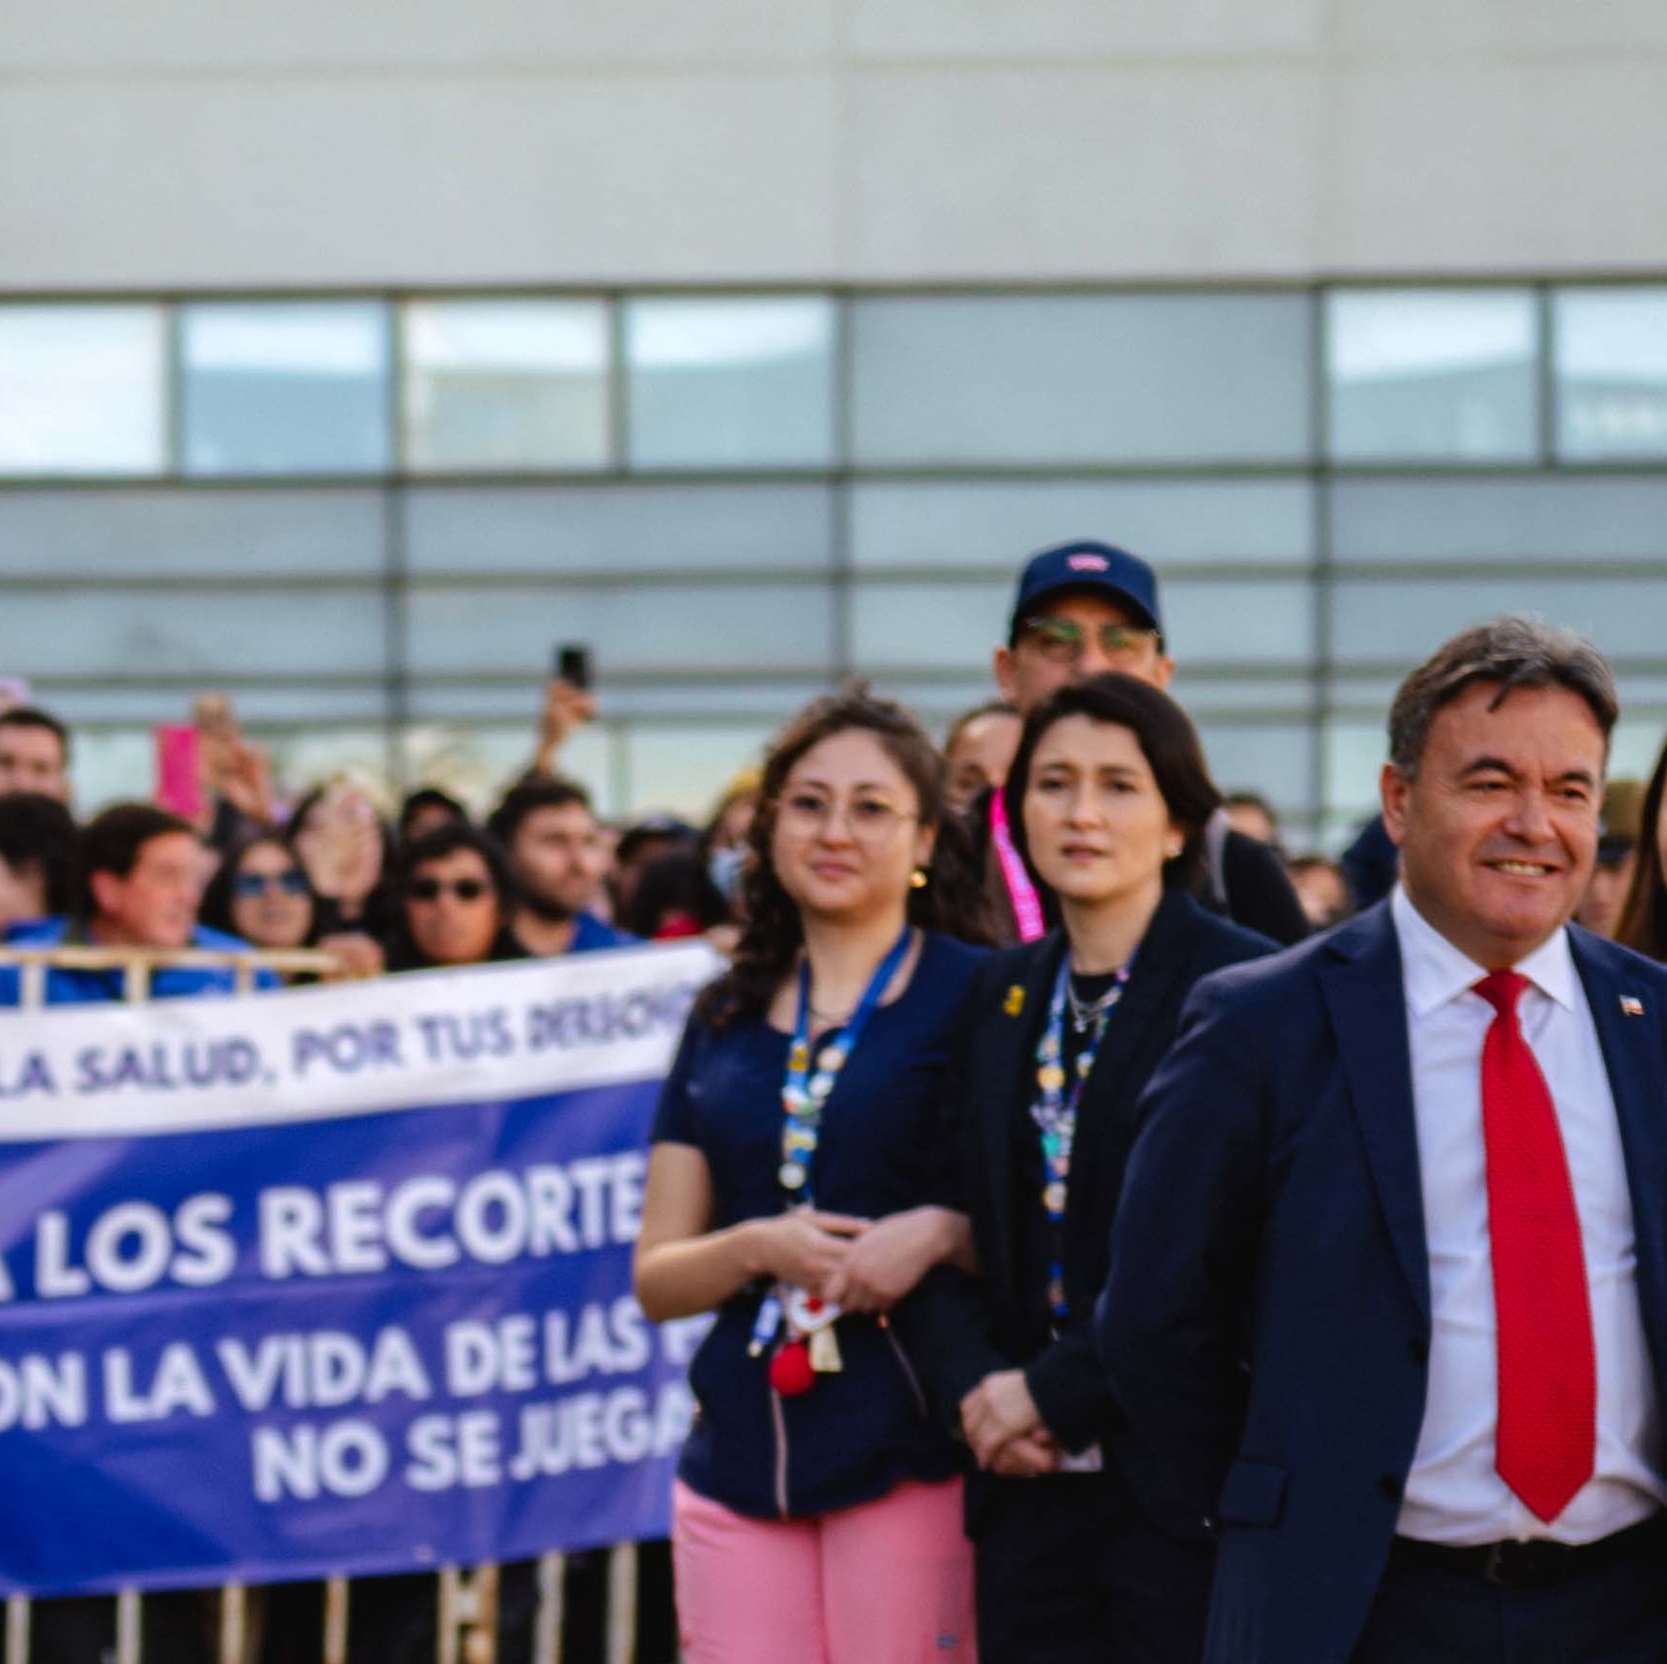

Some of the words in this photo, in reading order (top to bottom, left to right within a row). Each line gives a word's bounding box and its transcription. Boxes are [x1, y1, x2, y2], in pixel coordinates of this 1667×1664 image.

[73, 1036, 277, 1093] SALUD,
[292, 1020, 403, 1076] POR
[418, 1002, 517, 1062] TUS
[34, 1193, 238, 1297] LOS
[103, 1342, 216, 1424] LA
[216, 1325, 431, 1412] VIDA
[444, 1313, 537, 1398] DE
[543, 1295, 651, 1385] LAS
[253, 1418, 389, 1503] NO
[405, 1408, 501, 1493] SE
